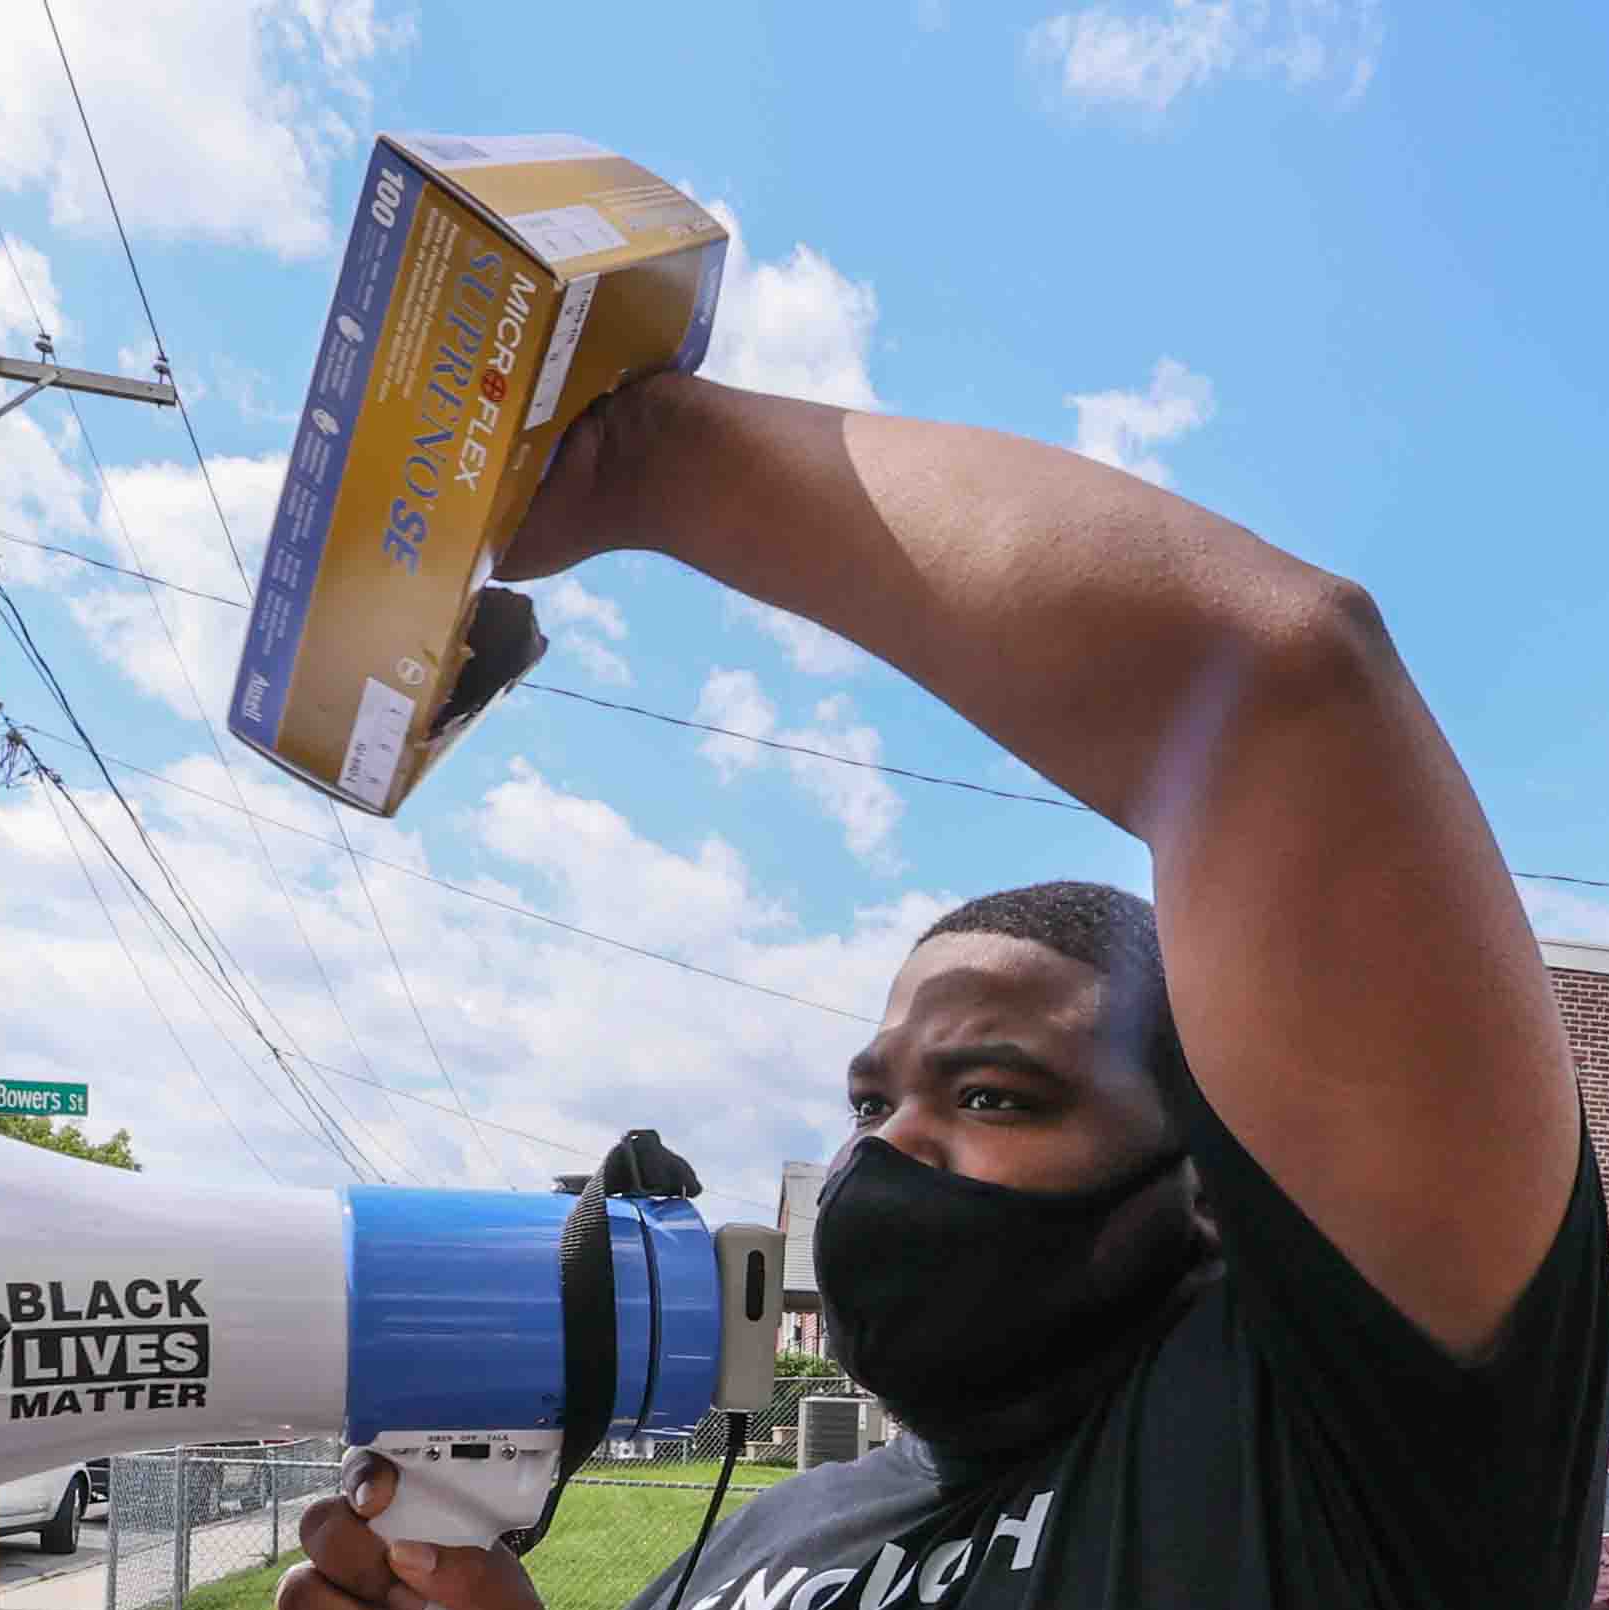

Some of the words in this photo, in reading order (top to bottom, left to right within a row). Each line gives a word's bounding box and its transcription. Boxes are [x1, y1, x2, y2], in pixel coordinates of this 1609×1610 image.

[373, 168, 405, 228] 100
[69, 1093, 84, 1112] St
[6, 1279, 207, 1323] BLACK
[23, 1332, 200, 1381] LIVES
[9, 1383, 207, 1420] MATTER
